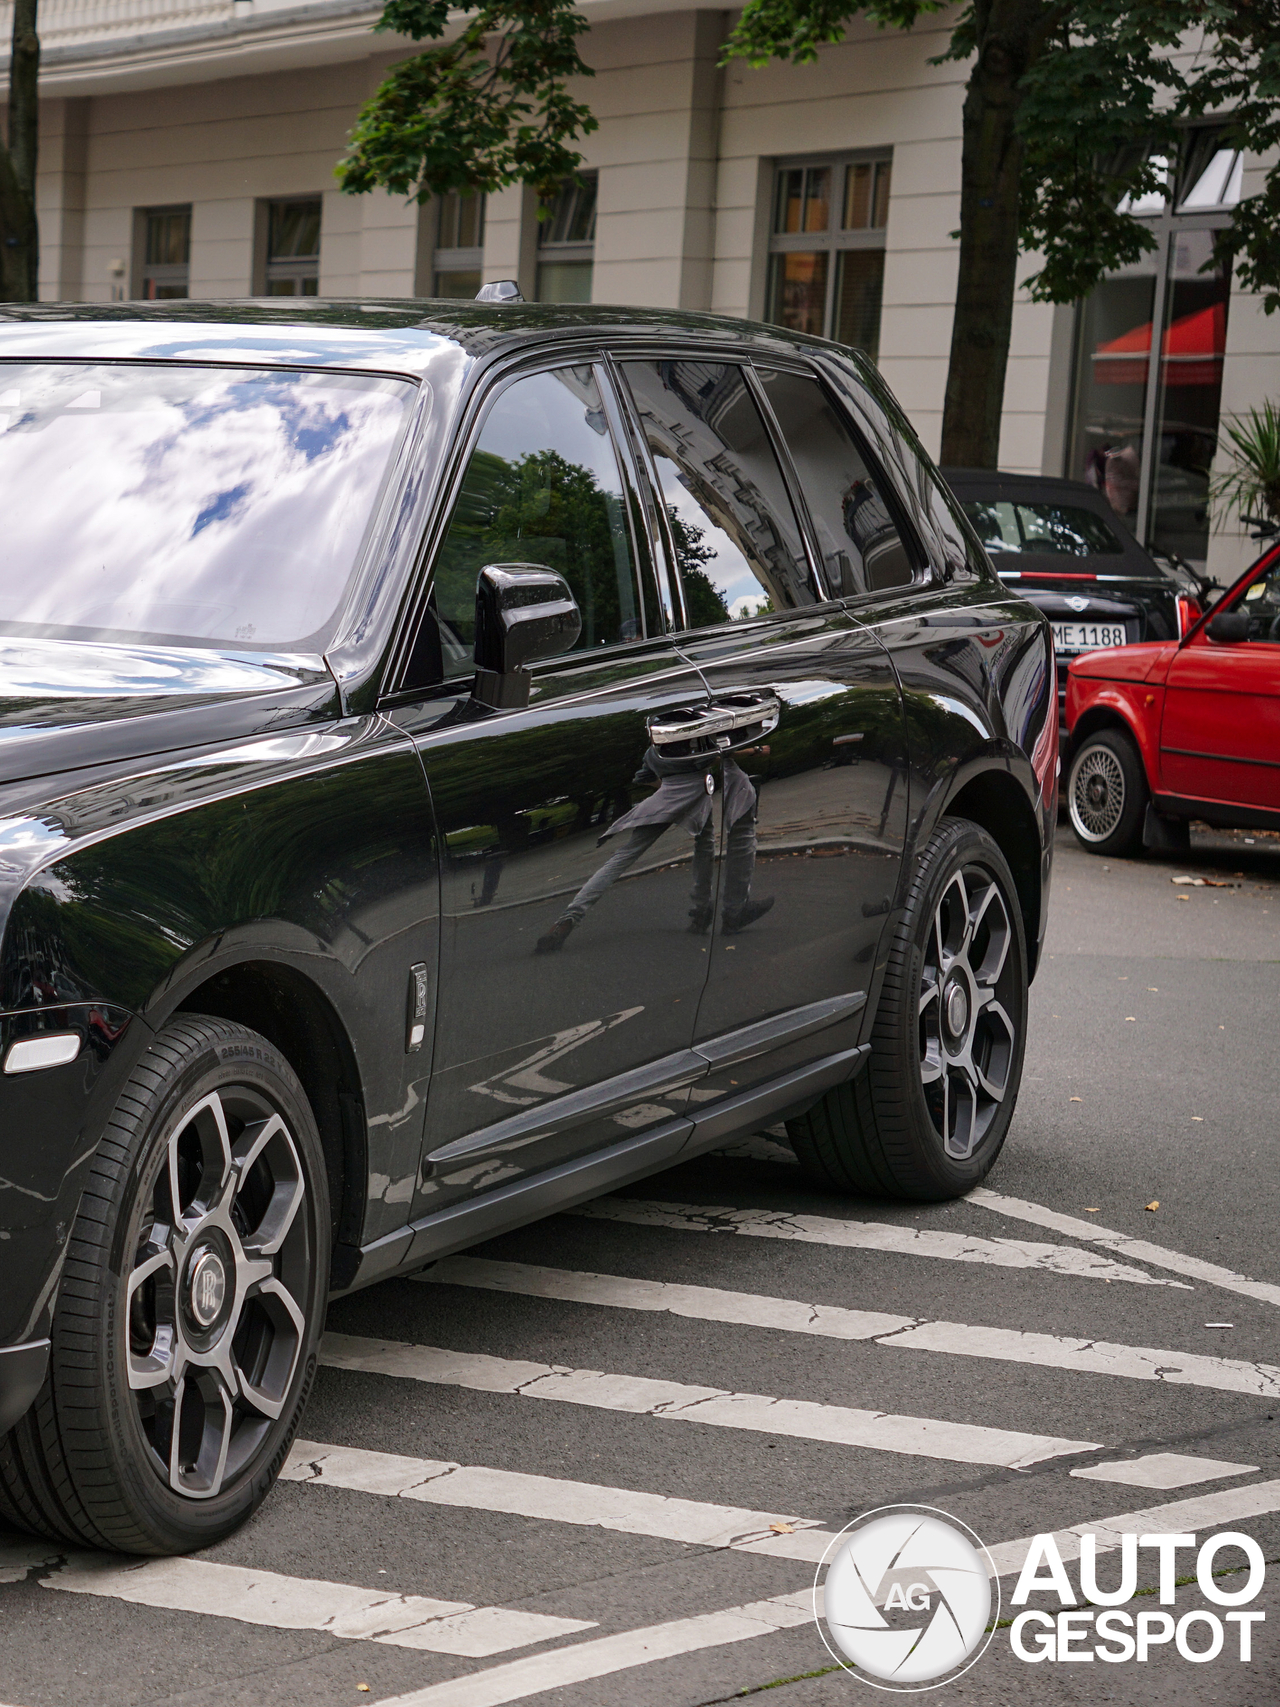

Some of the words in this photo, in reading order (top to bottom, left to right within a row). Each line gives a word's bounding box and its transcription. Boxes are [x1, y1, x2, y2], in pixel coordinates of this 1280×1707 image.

[1052, 626, 1074, 645] ME
[1079, 626, 1122, 646] 1188
[222, 1045, 254, 1059] 255/45
